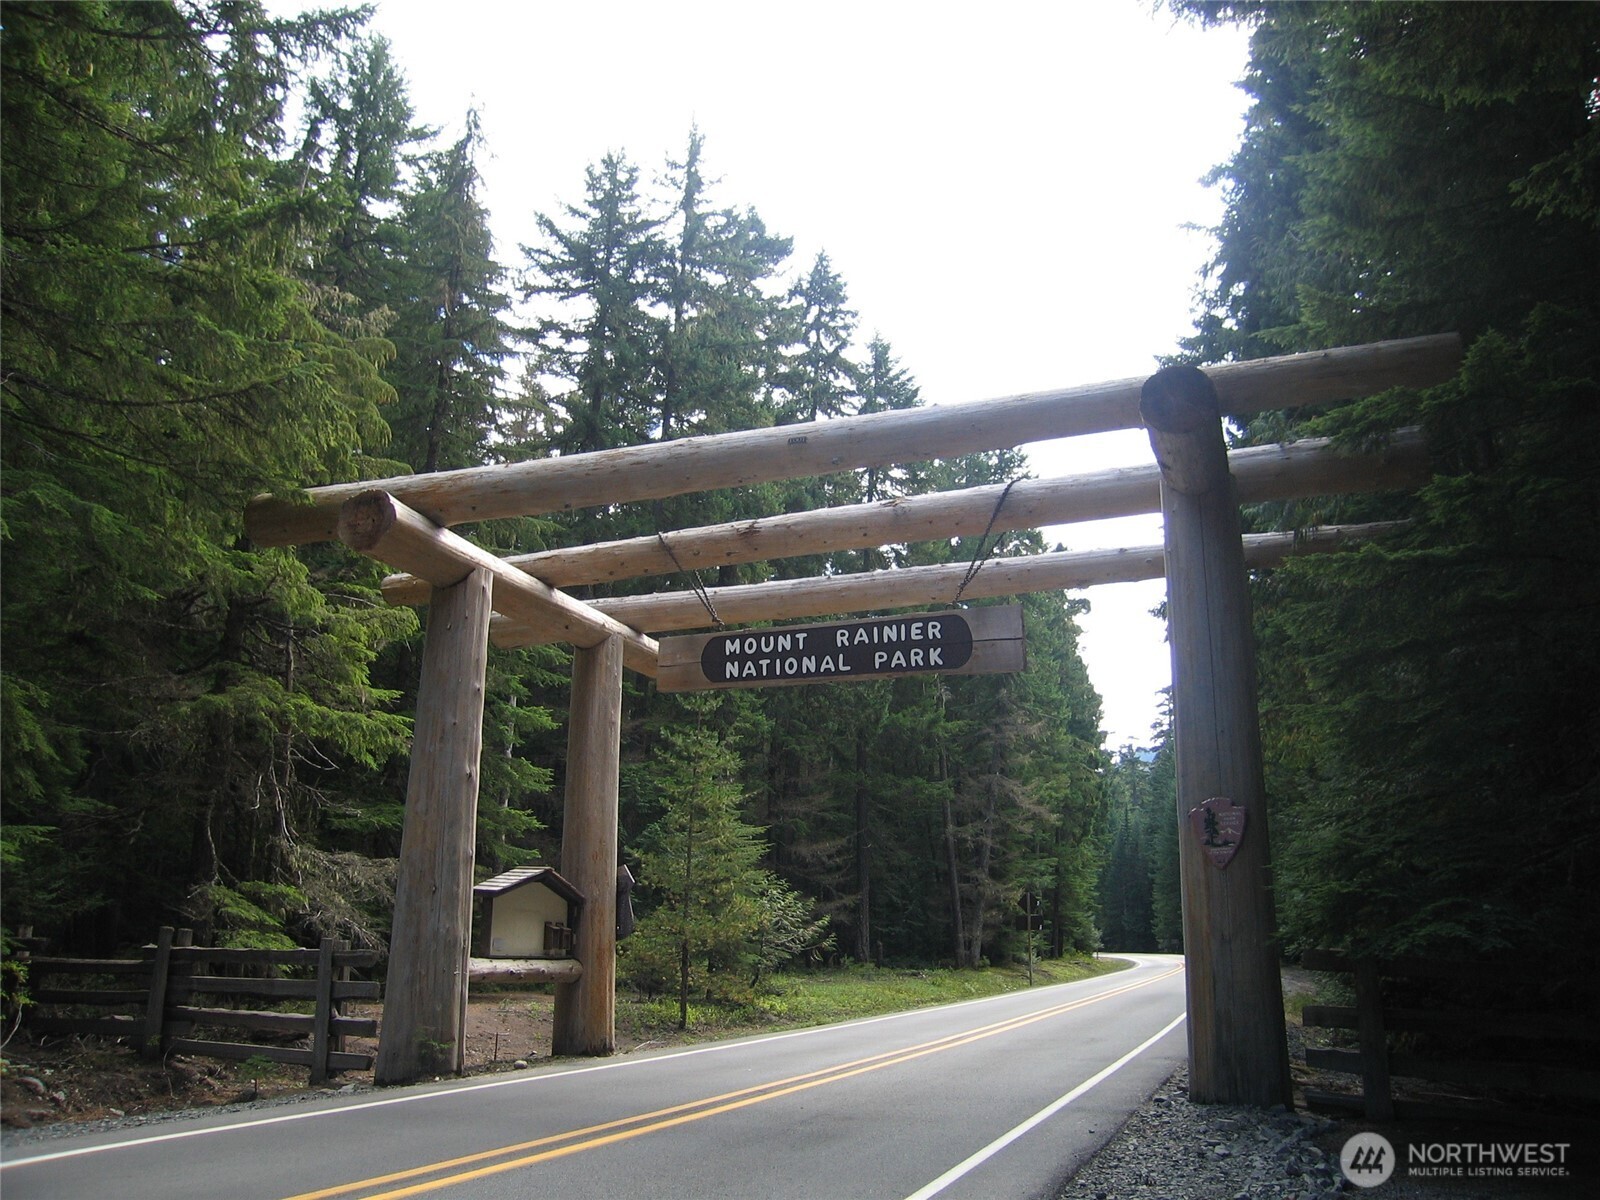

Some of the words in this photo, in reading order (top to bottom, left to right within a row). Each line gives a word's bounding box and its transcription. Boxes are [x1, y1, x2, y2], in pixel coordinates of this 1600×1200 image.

[725, 633, 808, 655] MOUNT
[836, 621, 942, 647] RAINIER
[725, 653, 851, 679] NATIONAL
[874, 647, 944, 669] PARK
